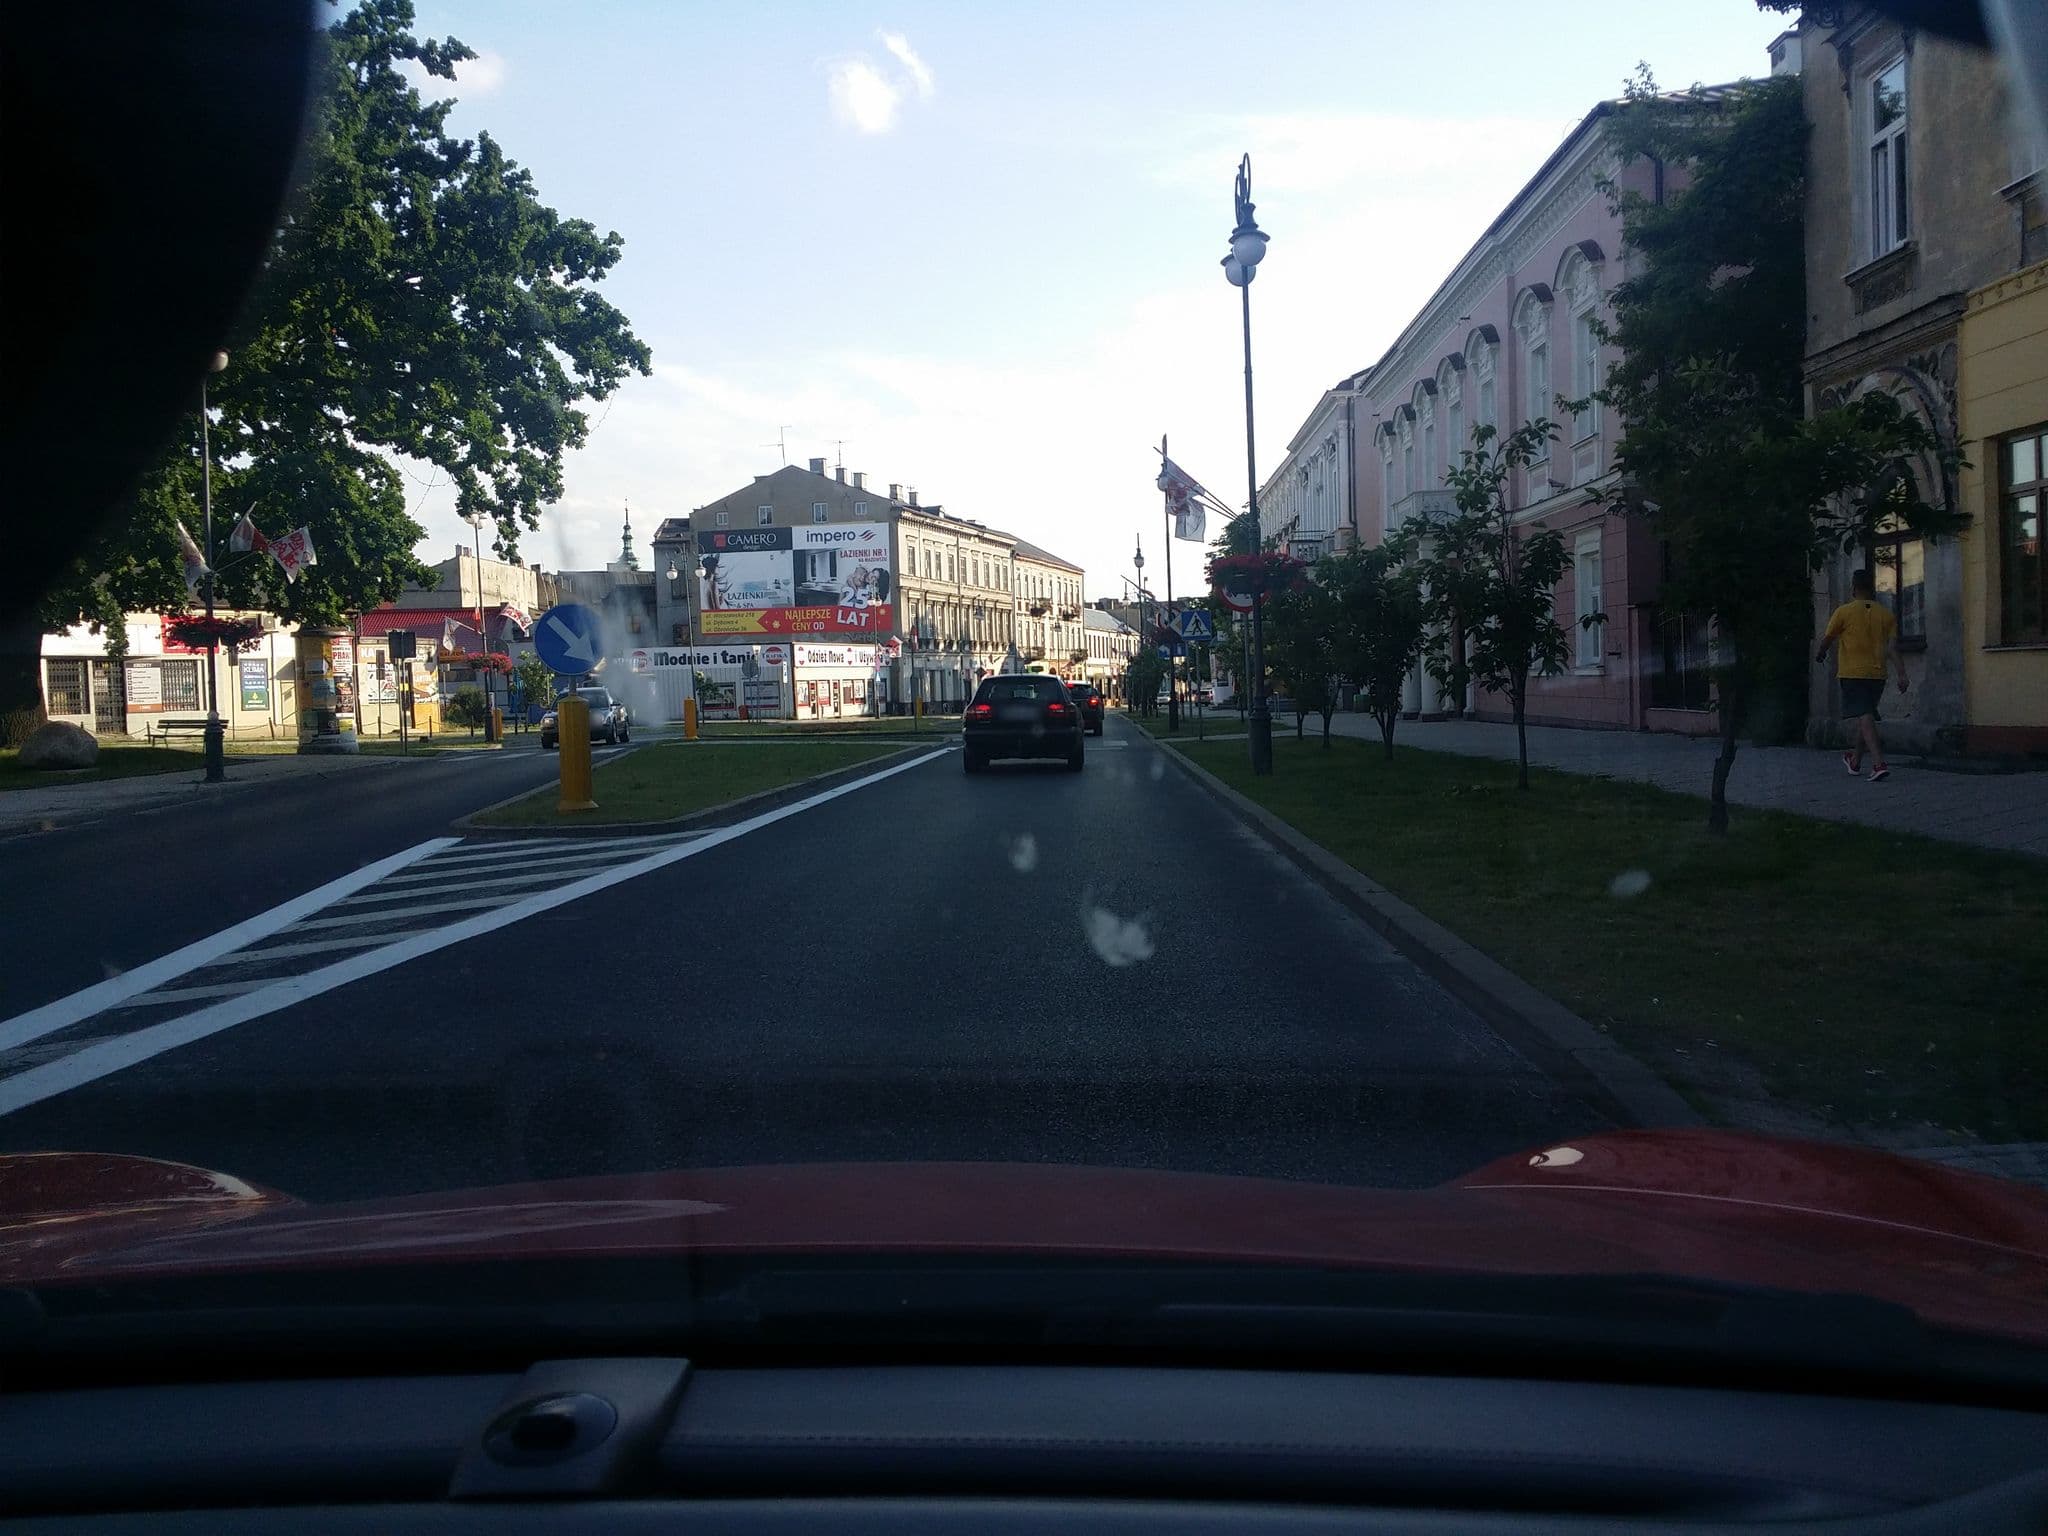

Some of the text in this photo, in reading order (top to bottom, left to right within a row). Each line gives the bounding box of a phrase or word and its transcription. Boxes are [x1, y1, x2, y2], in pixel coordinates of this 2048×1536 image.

[727, 533, 777, 546] CAMERO
[806, 530, 856, 544] impero
[839, 548, 871, 559] ŁAZIENKI
[872, 548, 883, 557] NR
[727, 591, 764, 601] ŁAZIENKI
[839, 586, 869, 609] 25
[785, 608, 831, 621] NAJLEPSZE
[837, 609, 869, 627] LAT
[792, 621, 825, 631] CENY OD
[653, 651, 710, 666] Modnie
[713, 652, 718, 664] i
[829, 650, 845, 663] Nowa
